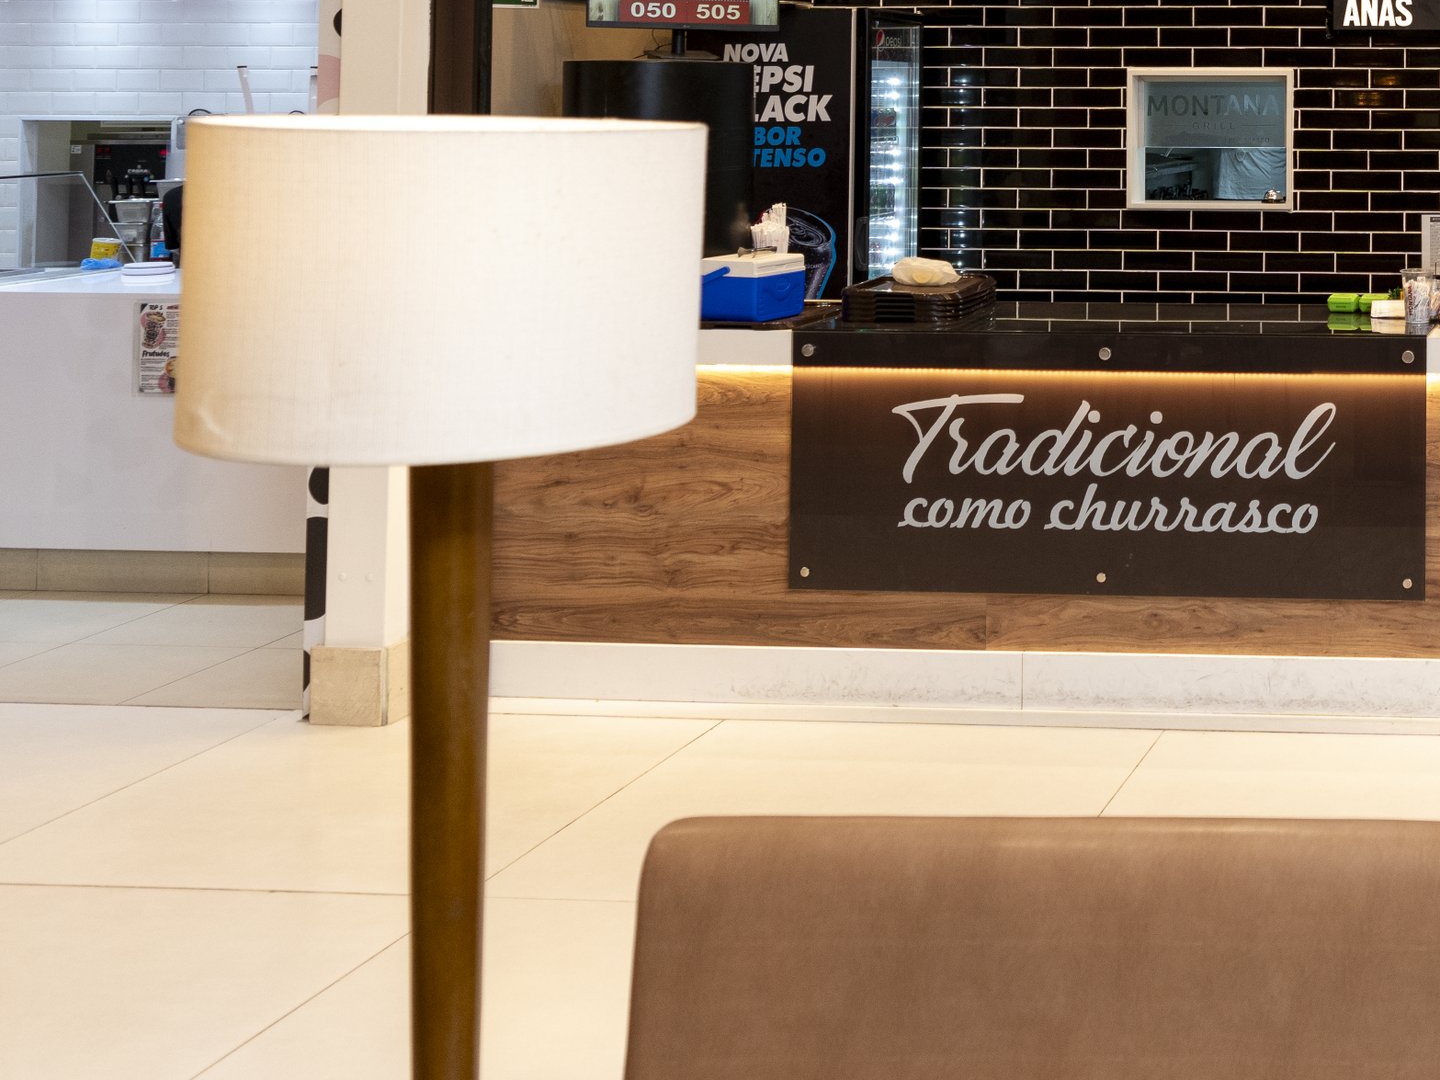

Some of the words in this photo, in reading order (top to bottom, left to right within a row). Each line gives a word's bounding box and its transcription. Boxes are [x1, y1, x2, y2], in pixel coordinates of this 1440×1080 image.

[630, 2, 677, 19] 050
[696, 4, 741, 20] 505
[723, 43, 789, 63] NOVA
[755, 94, 833, 122] ACK
[1147, 94, 1280, 116] MONTANA
[892, 394, 1337, 484] Tradicional
[897, 496, 1032, 528] como
[1044, 483, 1319, 534] churrasco
